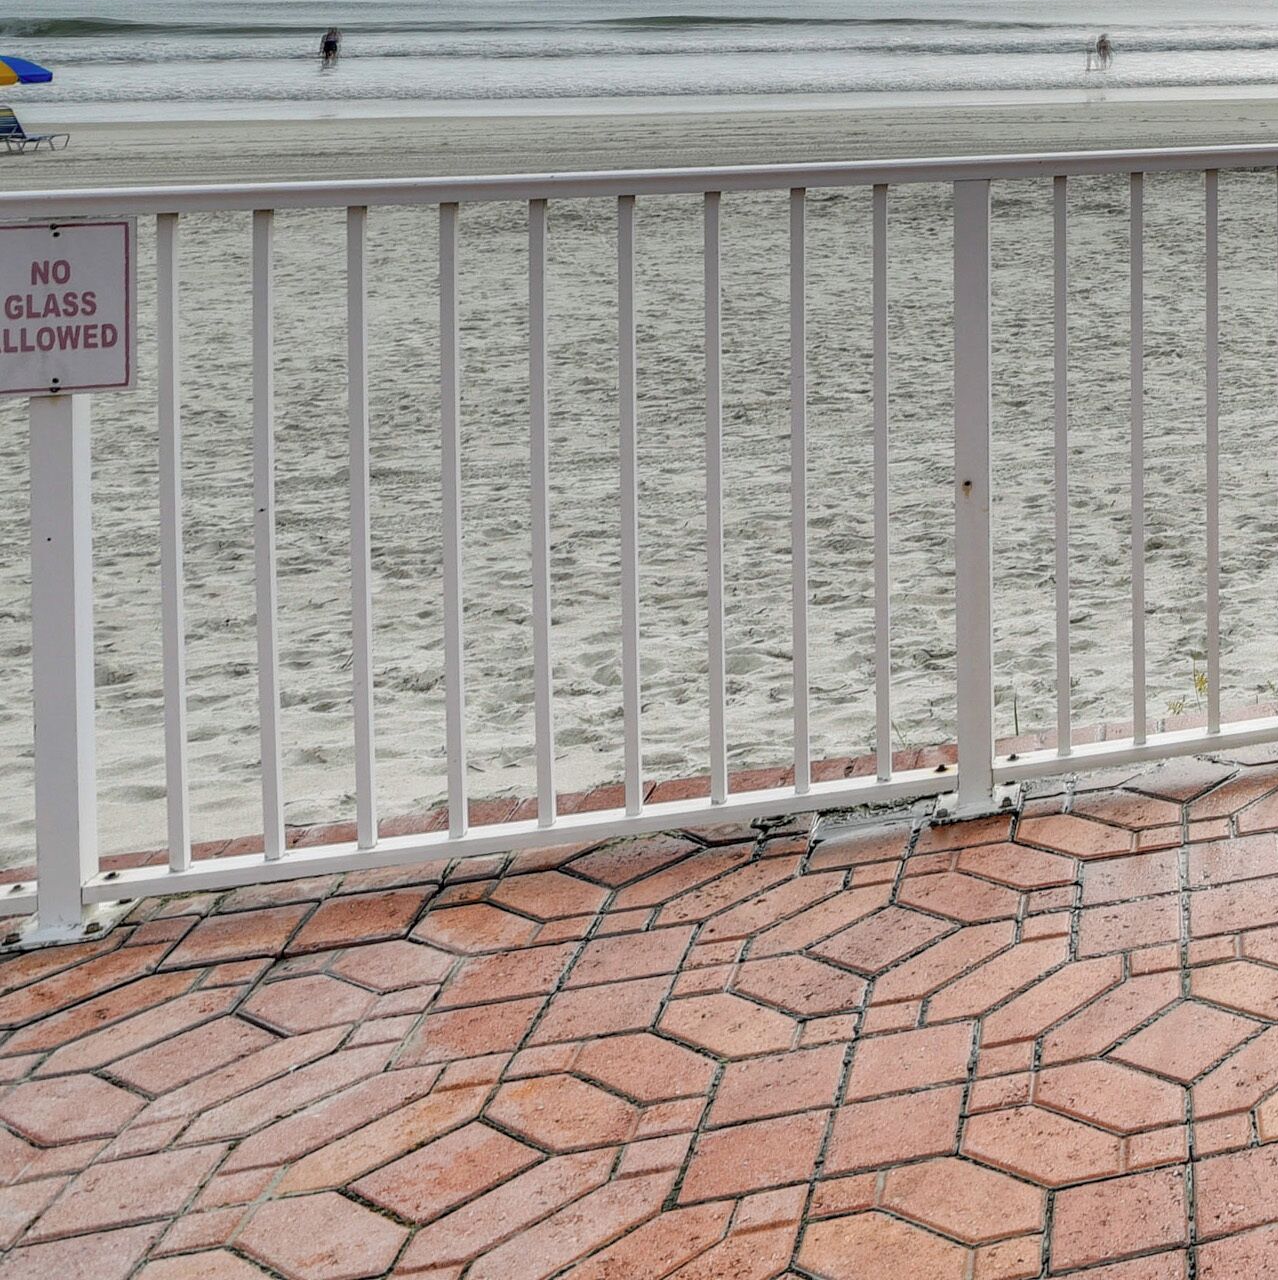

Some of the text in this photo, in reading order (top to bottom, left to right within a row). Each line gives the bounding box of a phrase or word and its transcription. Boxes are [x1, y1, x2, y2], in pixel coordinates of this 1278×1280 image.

[31, 259, 71, 285] NO
[4, 291, 97, 320] GLASS
[0, 323, 118, 353] LLOWED
